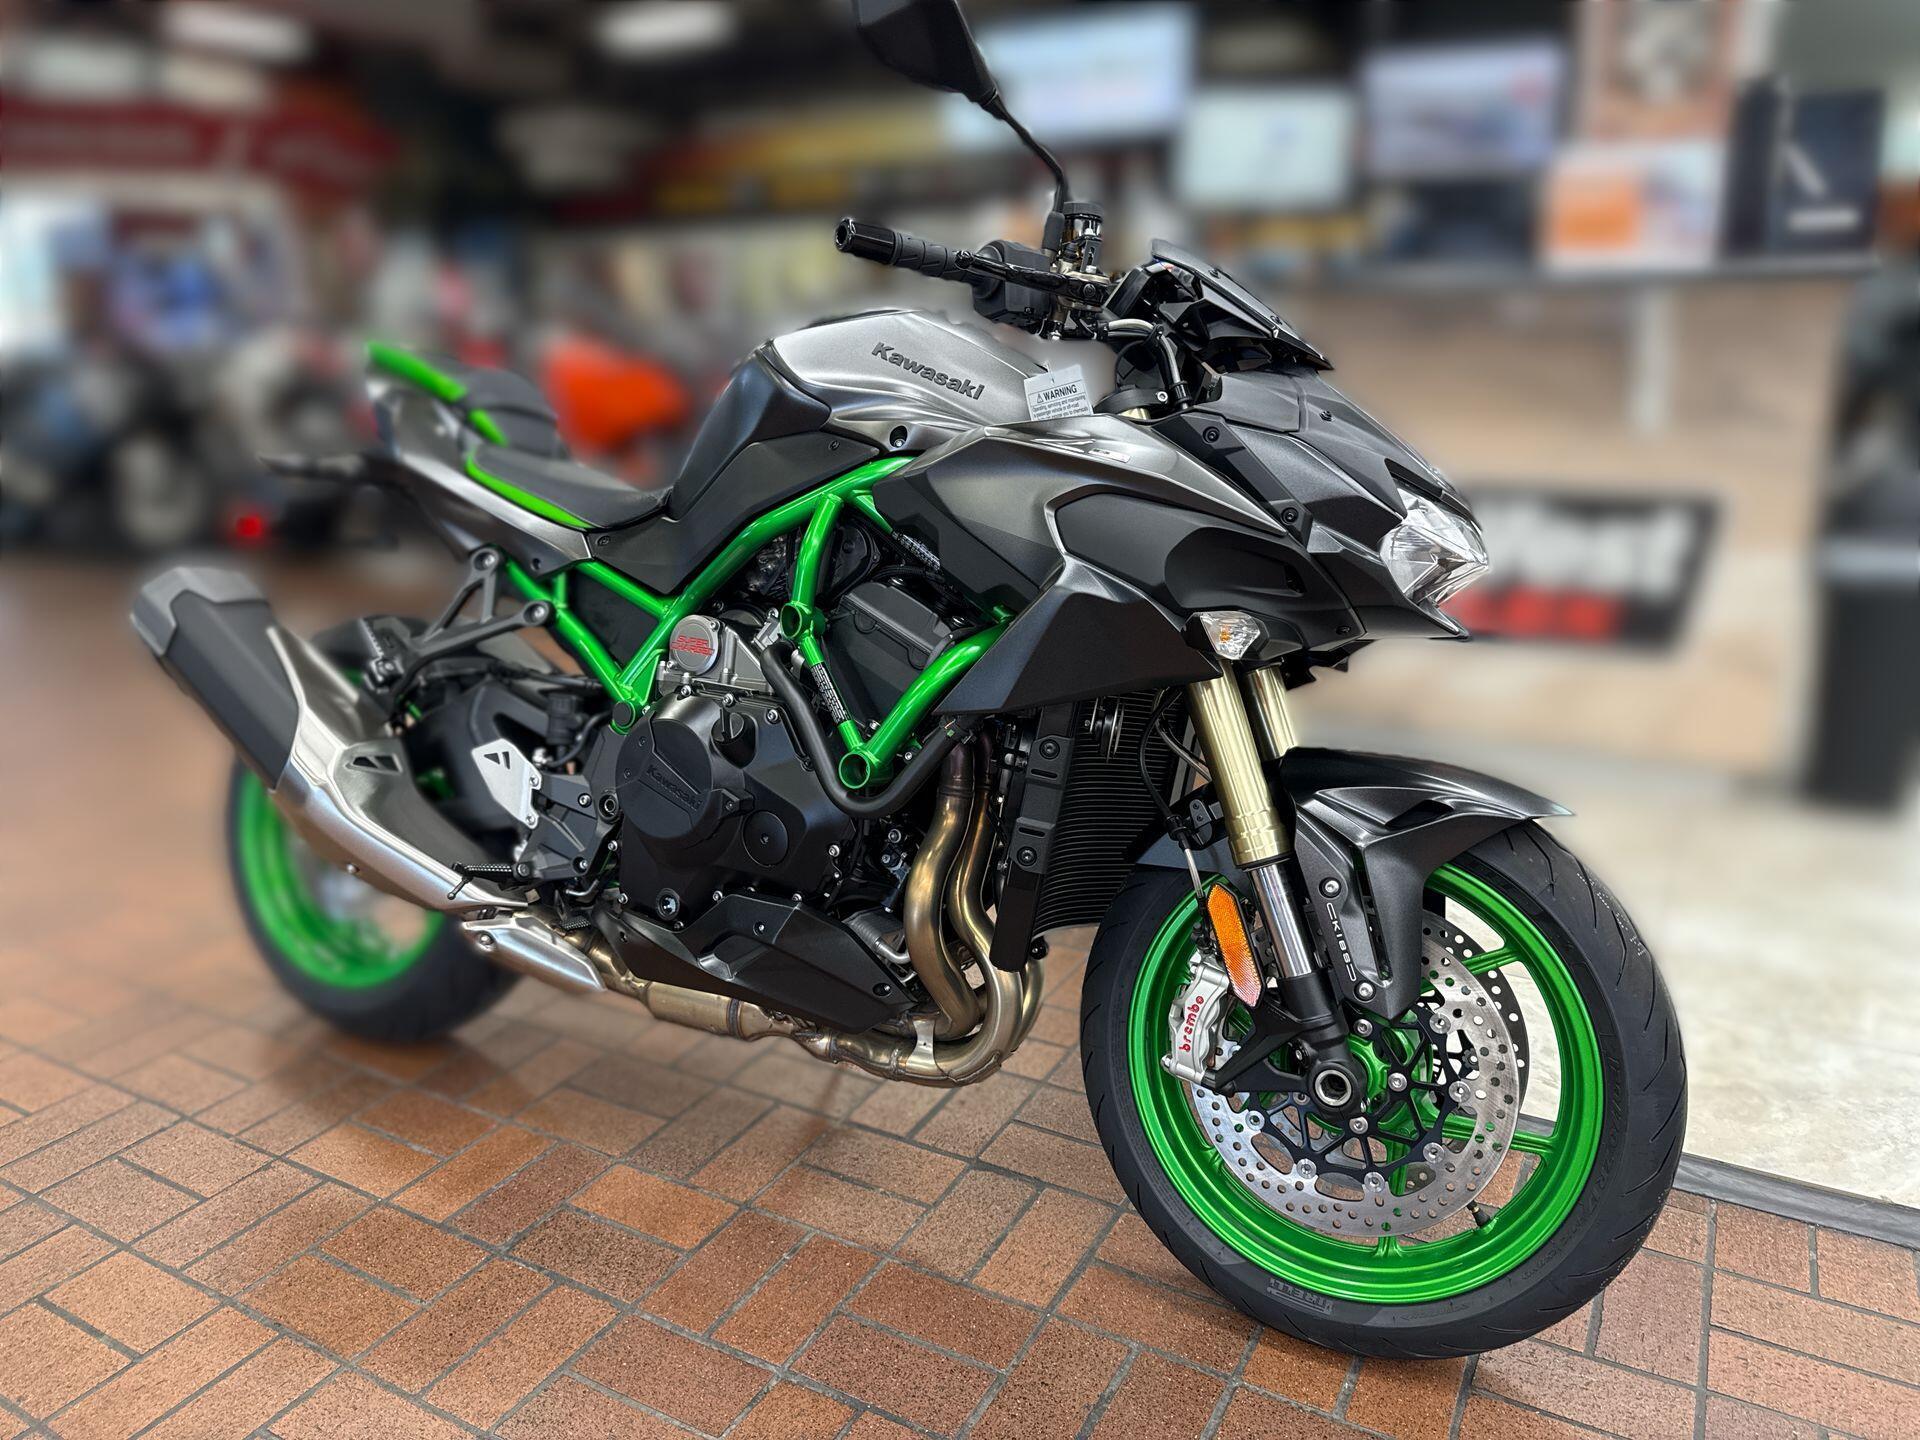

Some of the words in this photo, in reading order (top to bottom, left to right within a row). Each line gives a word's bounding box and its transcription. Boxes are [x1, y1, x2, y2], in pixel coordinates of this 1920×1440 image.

[871, 342, 985, 400] Kawasaki
[1043, 385, 1077, 400] WARNING
[646, 764, 703, 811] Kawasaki
[1178, 995, 1205, 1053] brembo
[1266, 1277, 1334, 1315] PIRELLI
